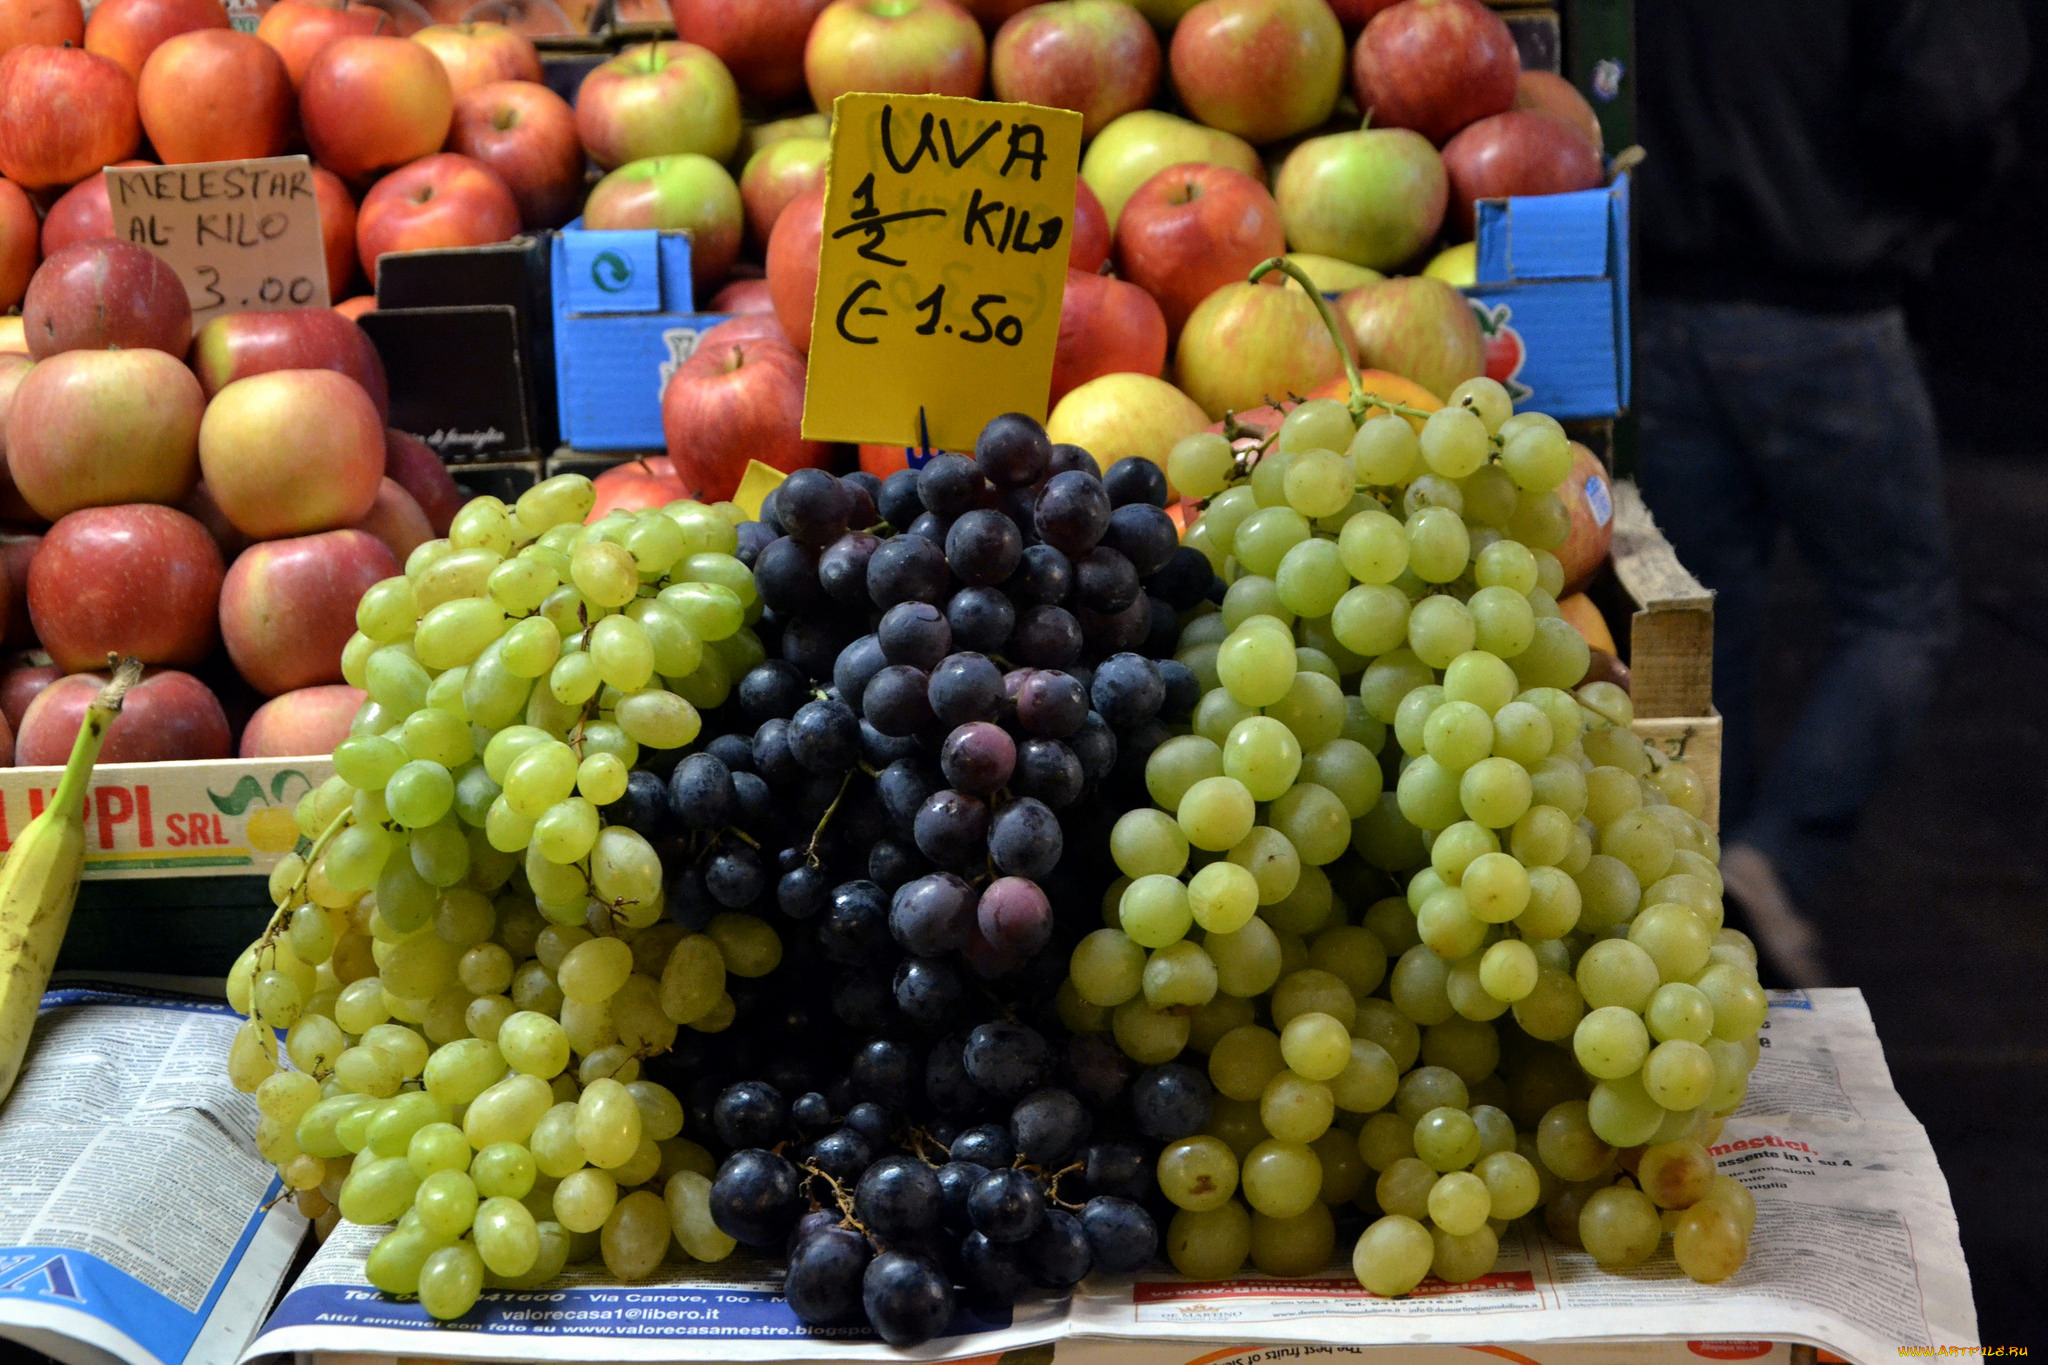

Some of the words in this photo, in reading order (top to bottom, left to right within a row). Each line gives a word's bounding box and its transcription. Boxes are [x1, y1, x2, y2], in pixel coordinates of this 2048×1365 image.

[880, 104, 1048, 181] UVA
[118, 167, 313, 205] MELESTAR
[197, 211, 289, 248] KILO
[193, 264, 314, 311] 3.00
[916, 284, 1023, 346] 1.50
[166, 813, 229, 847] SRL
[1717, 1151, 1779, 1168] assente
[1783, 1151, 1799, 1162] in
[1818, 1159, 1837, 1167] su
[344, 1289, 384, 1301] Tel.
[589, 1293, 619, 1303] Via
[625, 1293, 708, 1304] Caneve,
[315, 1312, 359, 1323] Altri
[362, 1315, 441, 1328] annunci
[443, 1321, 482, 1331] con
[488, 1322, 527, 1333] foto
[533, 1324, 556, 1333] su
[563, 1324, 875, 1337] www.valorecasamestre.blogspo
[502, 1308, 720, 1321] valorecasa1@libero.it
[1248, 1353, 1262, 1365] of
[1266, 1346, 1301, 1361] fruits
